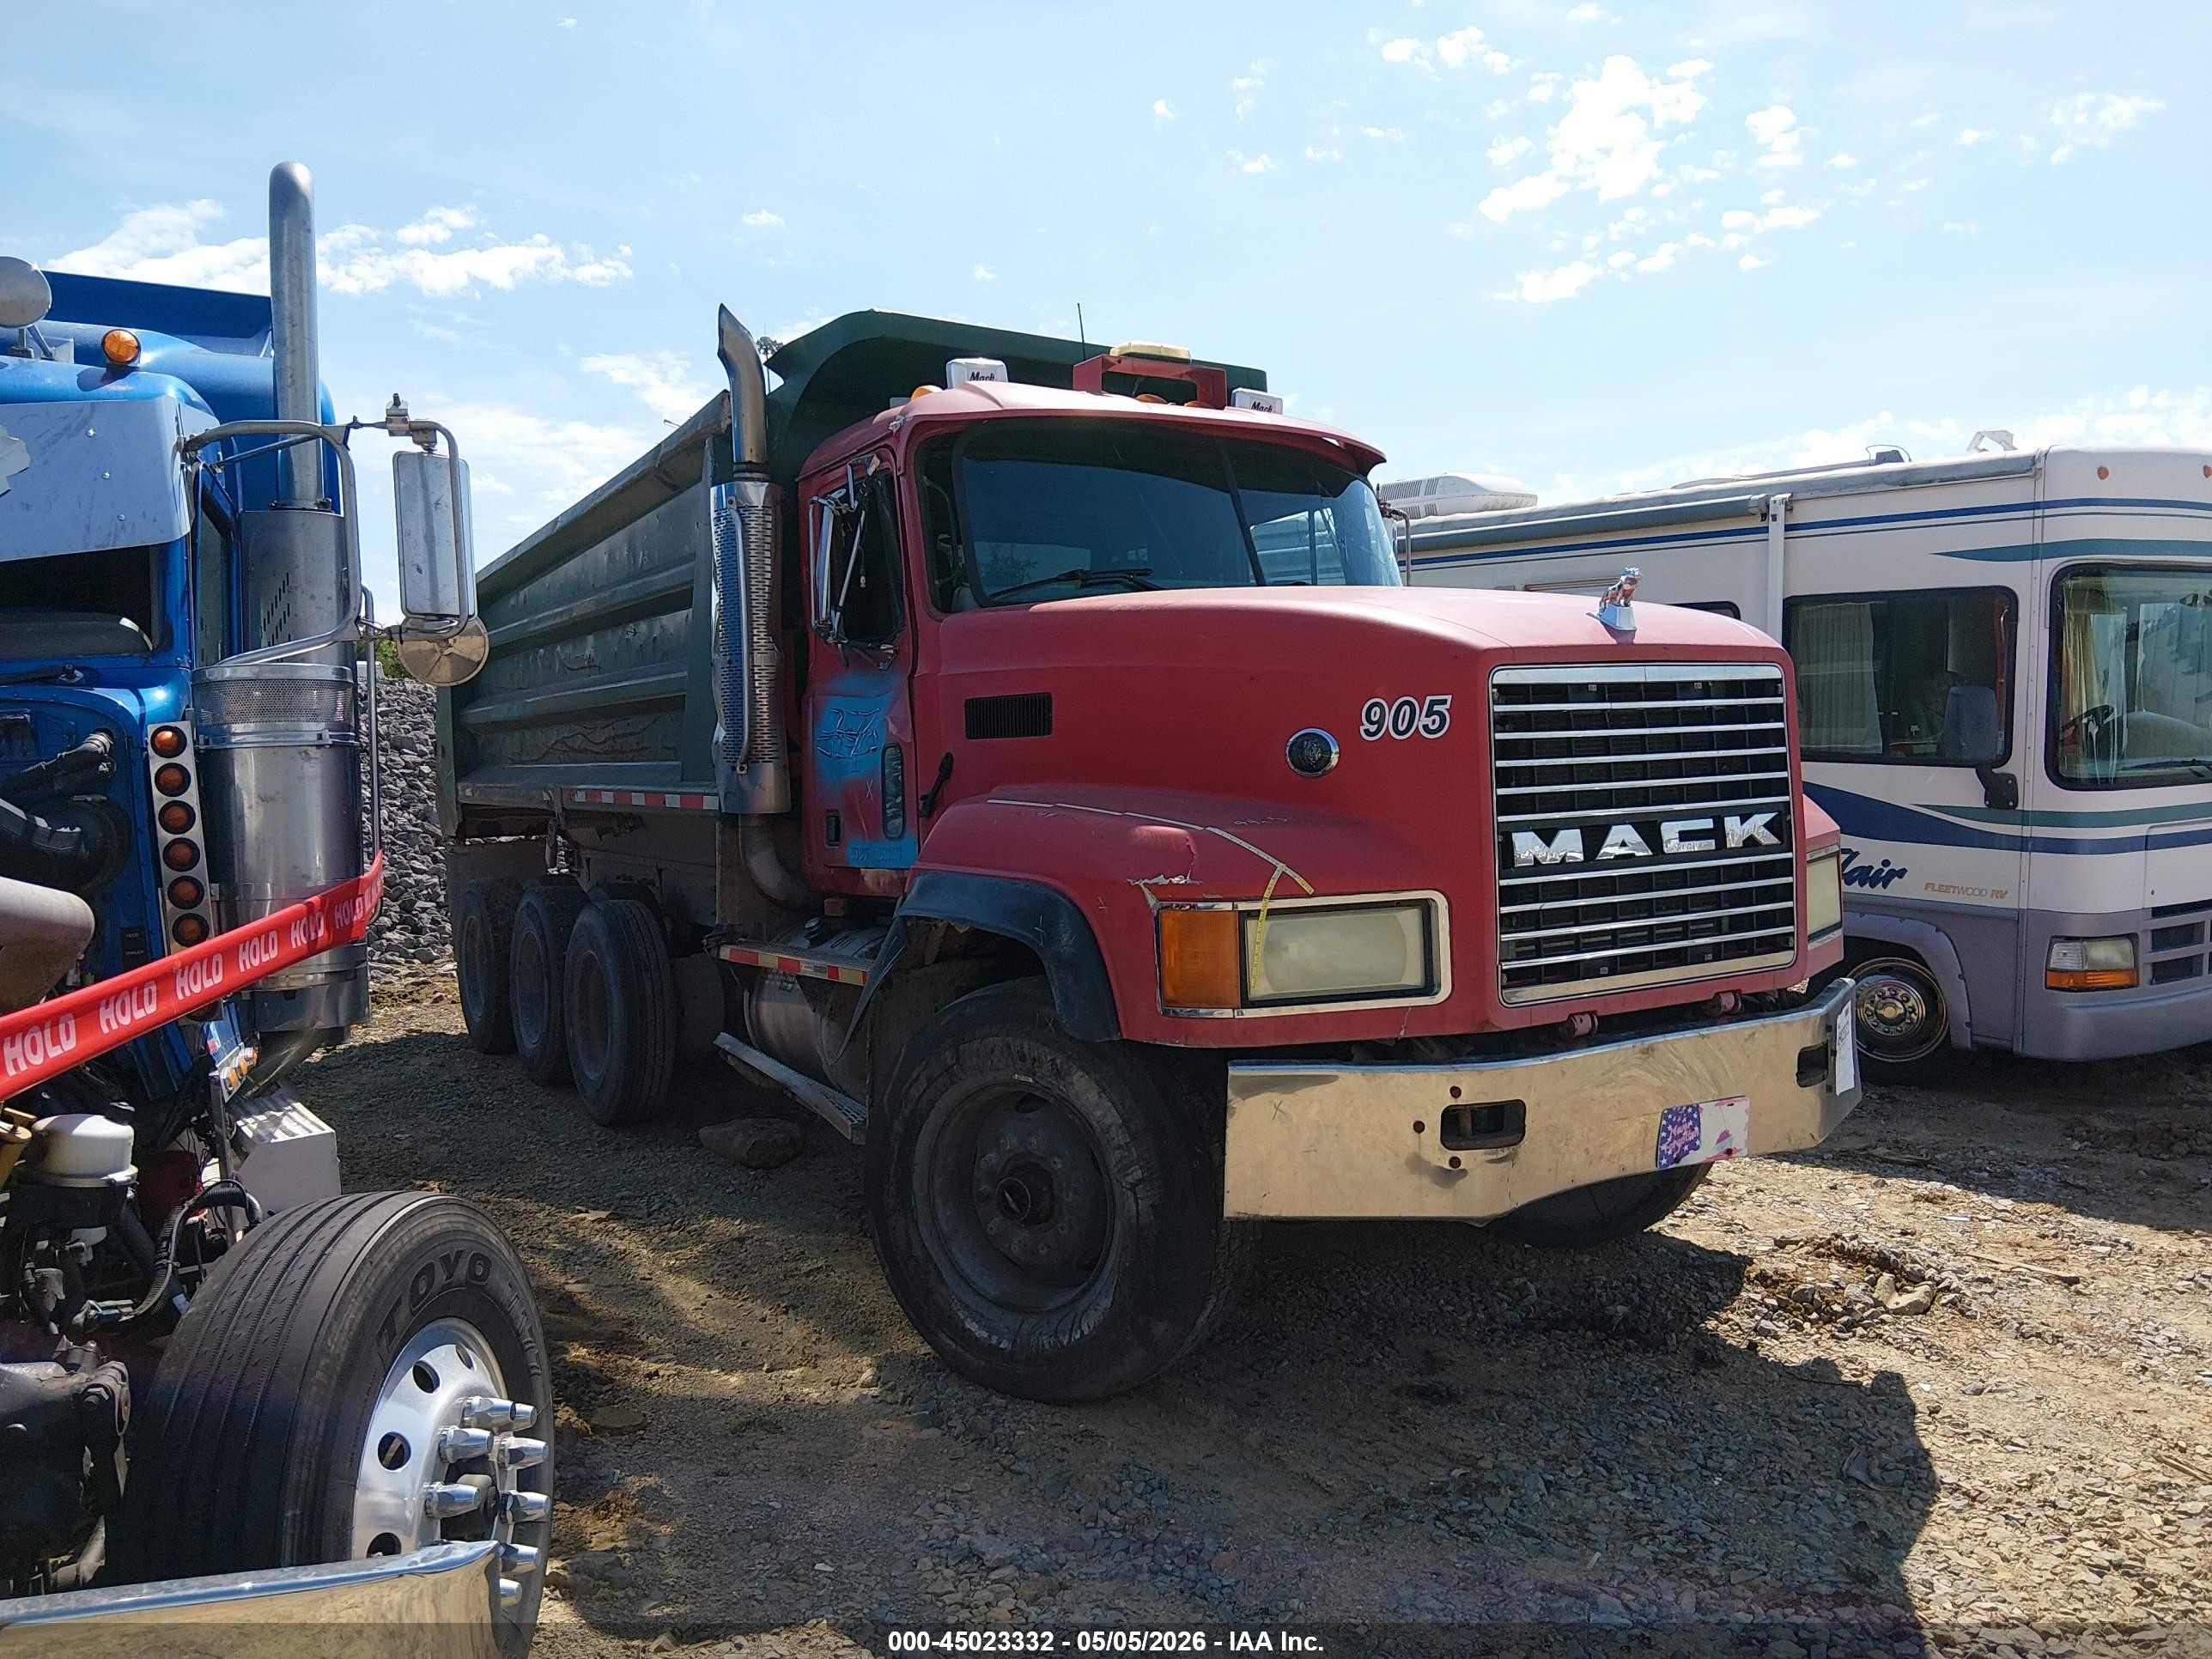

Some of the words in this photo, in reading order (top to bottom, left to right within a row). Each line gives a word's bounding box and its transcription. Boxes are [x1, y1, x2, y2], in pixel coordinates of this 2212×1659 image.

[1359, 695, 1452, 741] 905
[1511, 812, 1782, 868] MACK
[1840, 848, 1908, 890] lair
[1924, 882, 1988, 897] FLEETWOOD
[1990, 888, 2008, 899] RV
[3, 1013, 76, 1077] HOLD
[100, 980, 157, 1034] HOLD
[176, 953, 223, 1000] HOLD
[239, 930, 278, 972] HOLD
[290, 912, 325, 948] HOLD
[335, 896, 363, 929] HOLD
[376, 1249, 493, 1348] TOYO
